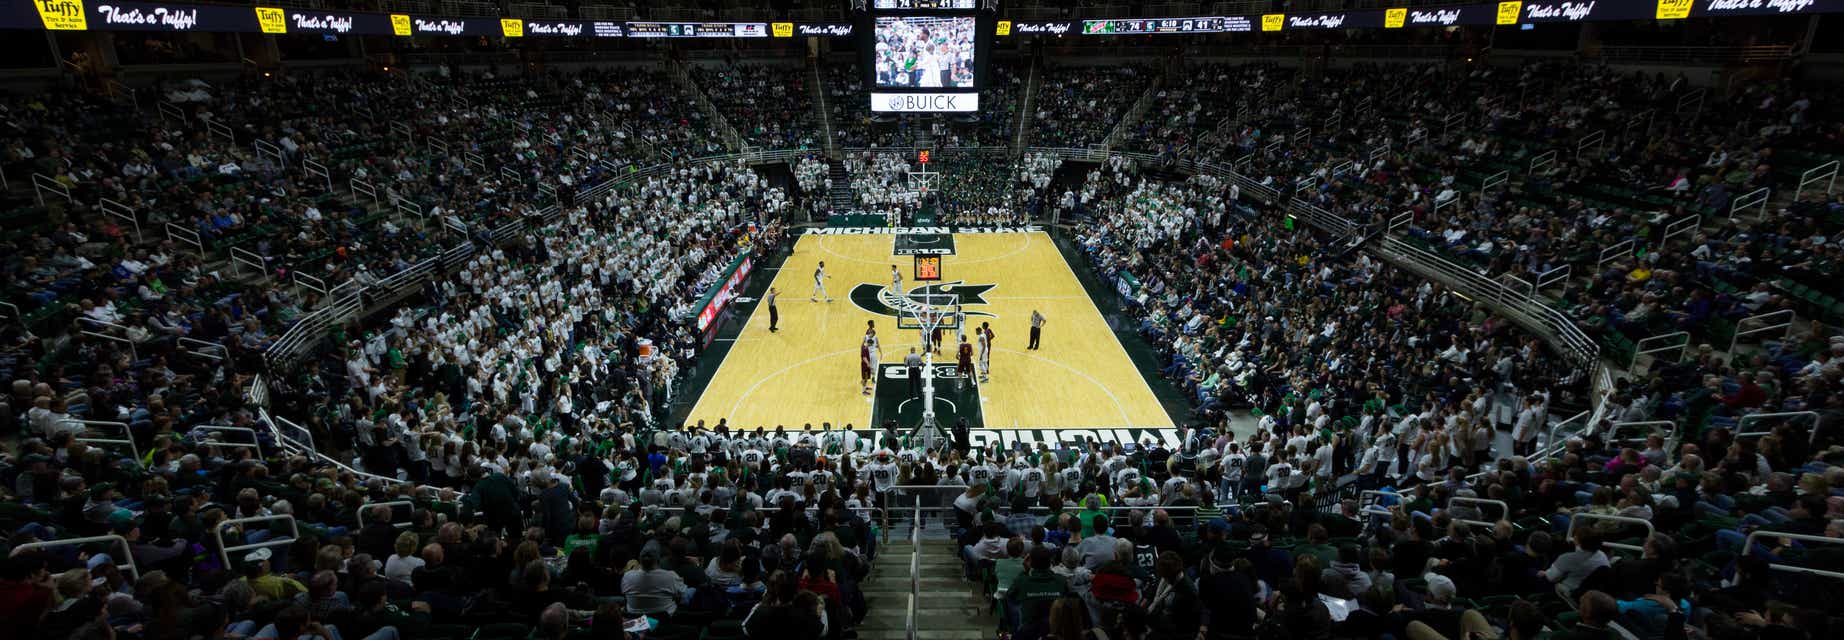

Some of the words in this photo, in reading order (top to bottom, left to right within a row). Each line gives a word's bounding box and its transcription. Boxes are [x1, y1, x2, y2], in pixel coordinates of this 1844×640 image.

[1527, 4, 1552, 18] That's
[1553, 8, 1560, 17] a
[1561, 1, 1595, 20] Tuffy!
[98, 5, 145, 24] That's
[146, 14, 157, 24] a
[155, 8, 197, 29] Tuffy!
[258, 10, 282, 23] Tuffy
[1290, 16, 1312, 27] That's
[1319, 15, 1345, 28] Tuffy!
[1411, 11, 1432, 23] That's
[1437, 9, 1460, 24] Tuffy!
[293, 14, 320, 28] That's
[326, 16, 352, 32] Tuffy!
[415, 20, 436, 31] That's
[441, 20, 464, 34] Tuffy!
[1130, 22, 1140, 31] 74
[1197, 21, 1208, 29] 41
[529, 23, 551, 33] That's
[557, 23, 582, 36] Tuffy!
[800, 25, 821, 34] That's
[828, 25, 852, 36] Tuffy!
[1017, 23, 1039, 32] That's
[1046, 23, 1071, 34] Tuffy!
[906, 95, 957, 109] BUICK
[746, 453, 757, 462] 20
[901, 454, 912, 462] 20
[1232, 458, 1242, 467] 20
[875, 470, 888, 479] 20
[975, 470, 987, 479] 20
[1029, 472, 1041, 481] 20
[1067, 470, 1080, 480] 20
[1278, 467, 1290, 477] 20
[791, 476, 803, 486] 20
[813, 475, 826, 485] 20
[1137, 553, 1154, 567] 23
